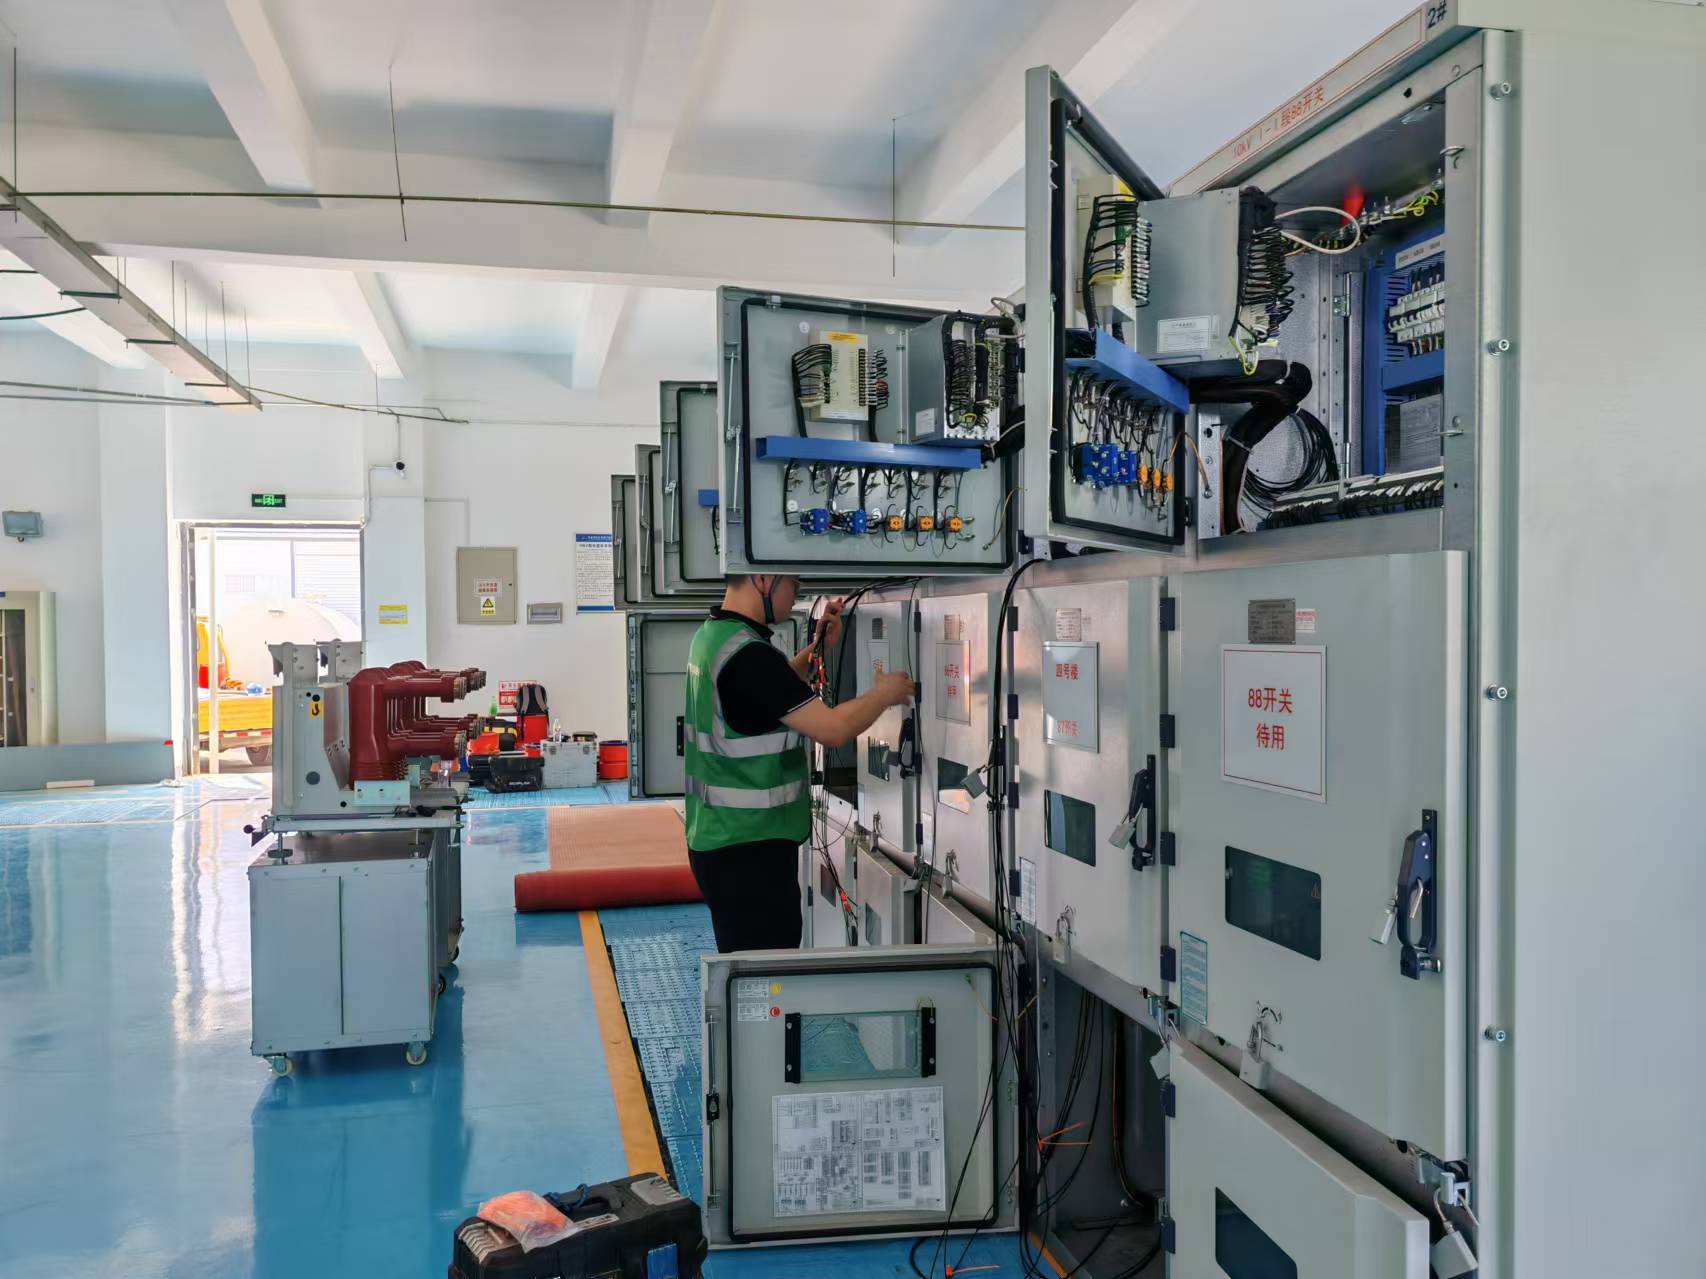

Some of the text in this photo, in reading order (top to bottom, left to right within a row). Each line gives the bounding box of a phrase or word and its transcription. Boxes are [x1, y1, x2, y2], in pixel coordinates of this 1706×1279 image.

[1427, 1, 1448, 29] 2#
[1247, 687, 1294, 715] 88开关
[1256, 722, 1285, 751] 待用
